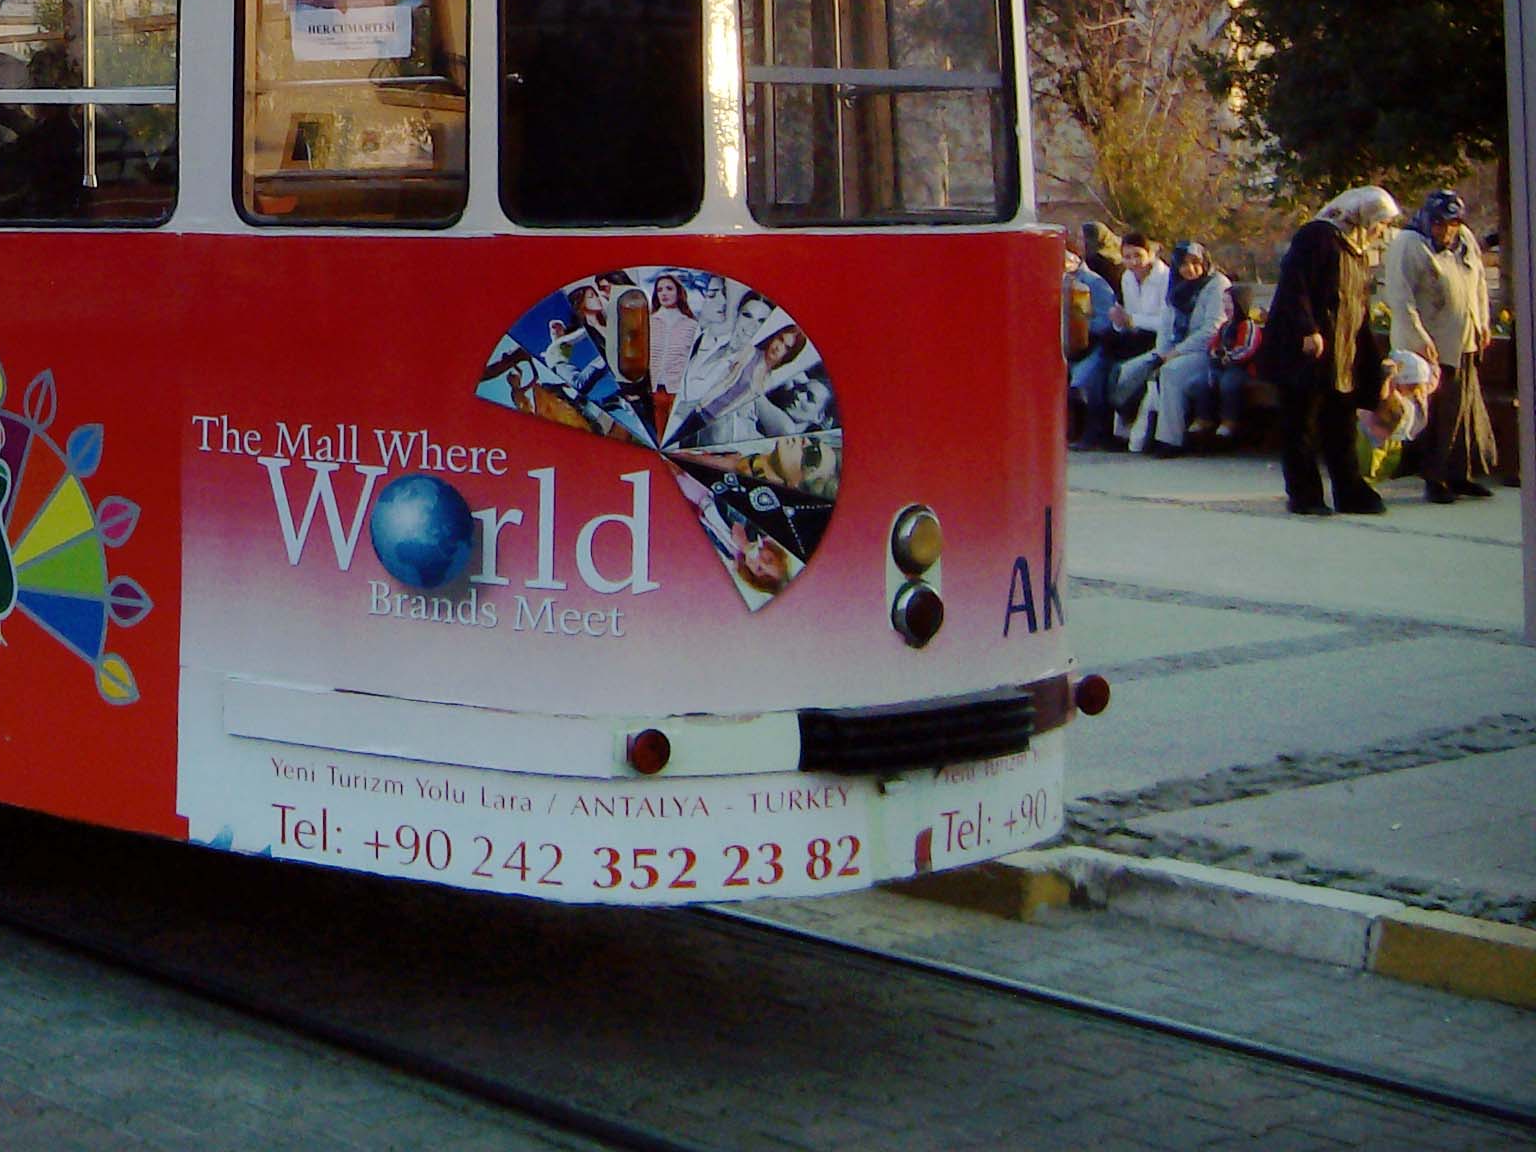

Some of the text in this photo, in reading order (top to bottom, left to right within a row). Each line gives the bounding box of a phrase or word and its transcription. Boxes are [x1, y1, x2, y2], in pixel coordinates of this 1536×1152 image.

[307, 23, 331, 35] HER
[191, 414, 508, 476] The Mall Where
[367, 579, 626, 638] Brands Meet
[271, 757, 316, 777] Yeni
[326, 764, 404, 796] Turizm
[415, 777, 466, 805] Yolu
[480, 785, 533, 812] Lara
[569, 794, 710, 819] ANTALYA
[748, 785, 851, 815] TURKEY
[271, 803, 862, 890] Tel: +90 242 352 23 82
[940, 800, 992, 853] Tel:
